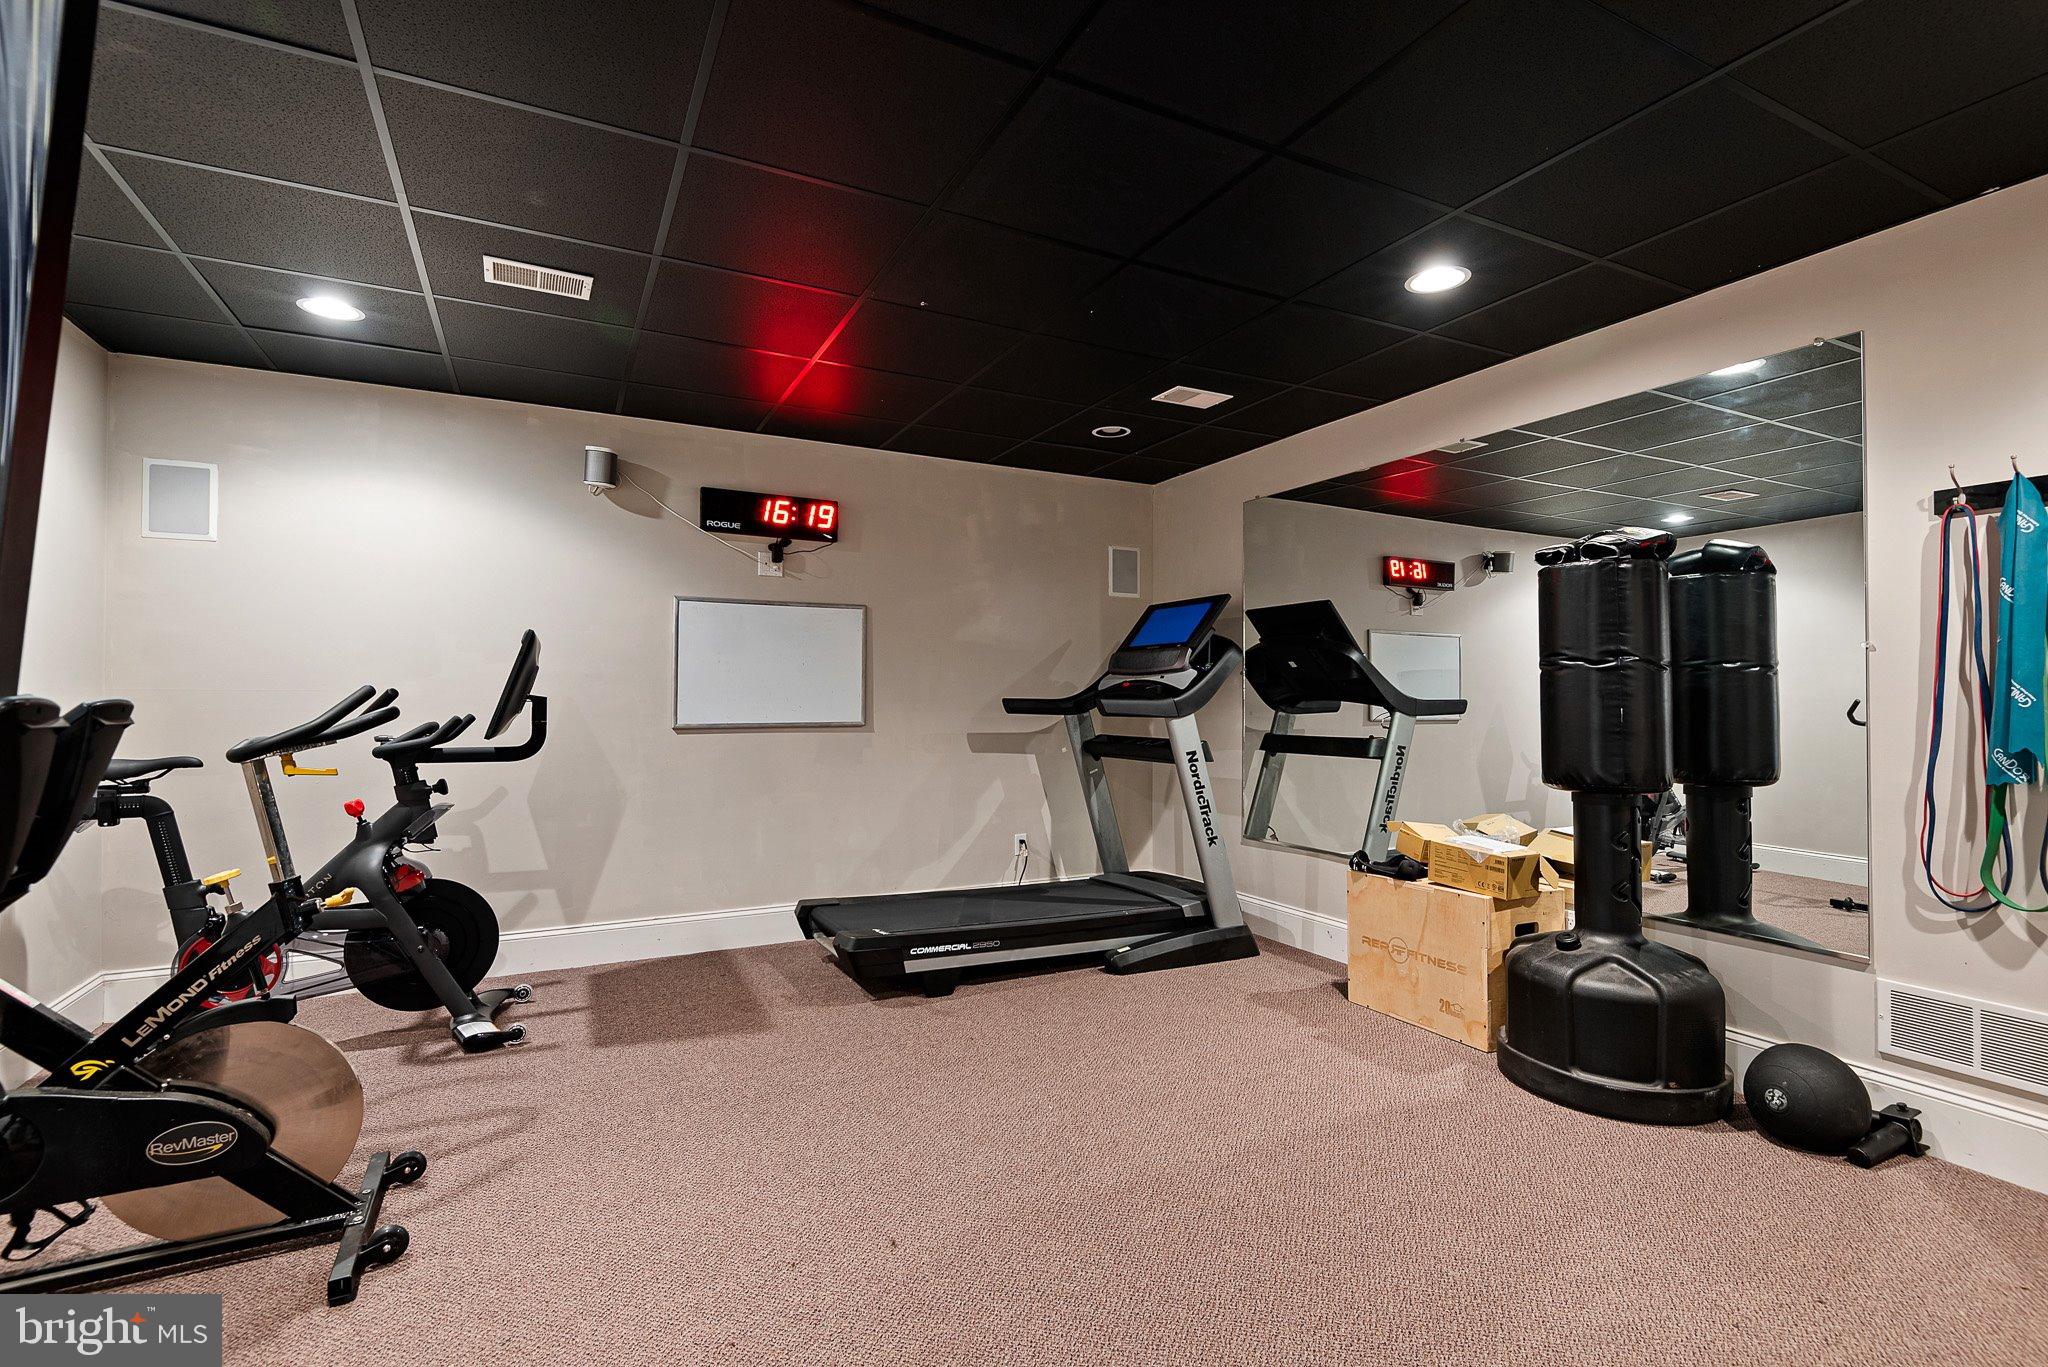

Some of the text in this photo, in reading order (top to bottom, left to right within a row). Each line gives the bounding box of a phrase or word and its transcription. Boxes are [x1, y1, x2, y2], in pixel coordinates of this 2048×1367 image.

[706, 519, 741, 530] ROGUE
[762, 499, 835, 529] 16:19
[1185, 749, 1219, 848] NordicTrack
[208, 934, 262, 981] Fitness
[909, 943, 972, 955] COMMERCIAL
[1407, 948, 1468, 976] FITNESS
[149, 1131, 236, 1156] RevMaster
